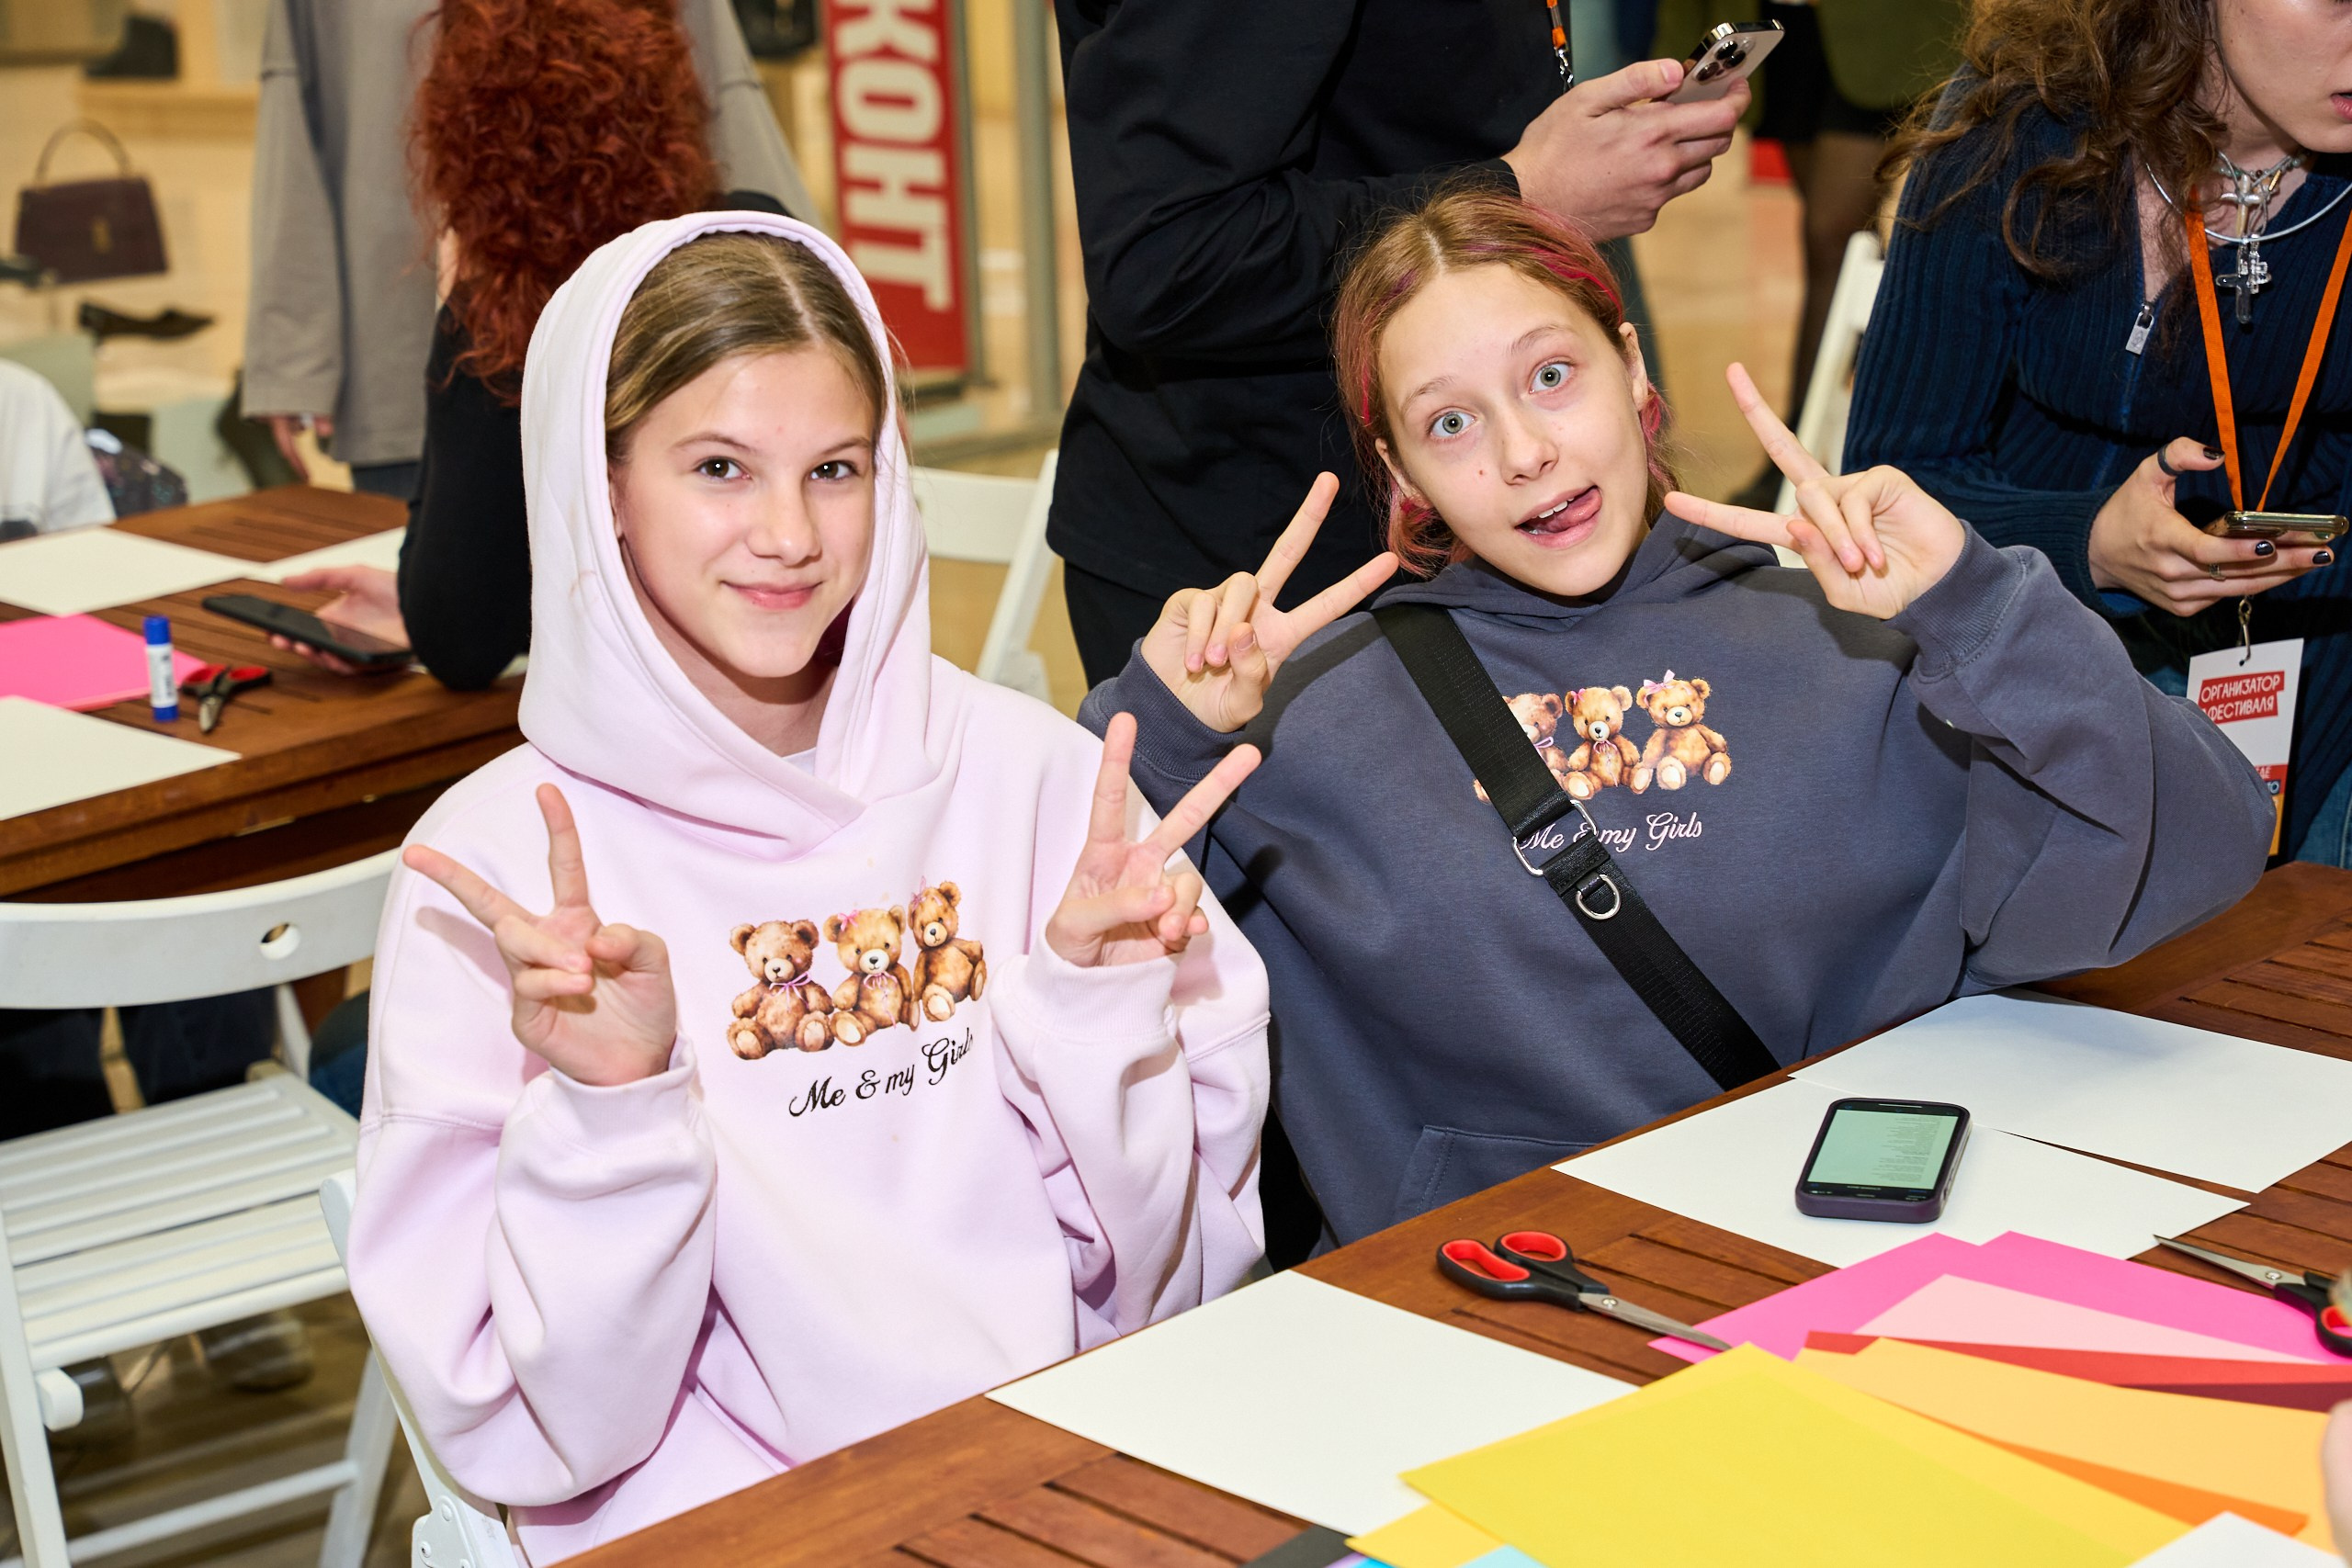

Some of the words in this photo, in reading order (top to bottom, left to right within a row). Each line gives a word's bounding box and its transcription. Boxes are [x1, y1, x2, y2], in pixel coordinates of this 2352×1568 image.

[2200, 674, 2280, 703] ОРГАНИЗАТОР
[2207, 694, 2275, 722] ФЕСТИВАЛЯ
[1520, 823, 1565, 850] Me
[1598, 827, 1637, 852] my
[1645, 812, 1702, 851] Girls
[788, 1076, 846, 1117] Me
[855, 1069, 881, 1100] &
[885, 1064, 915, 1097] my
